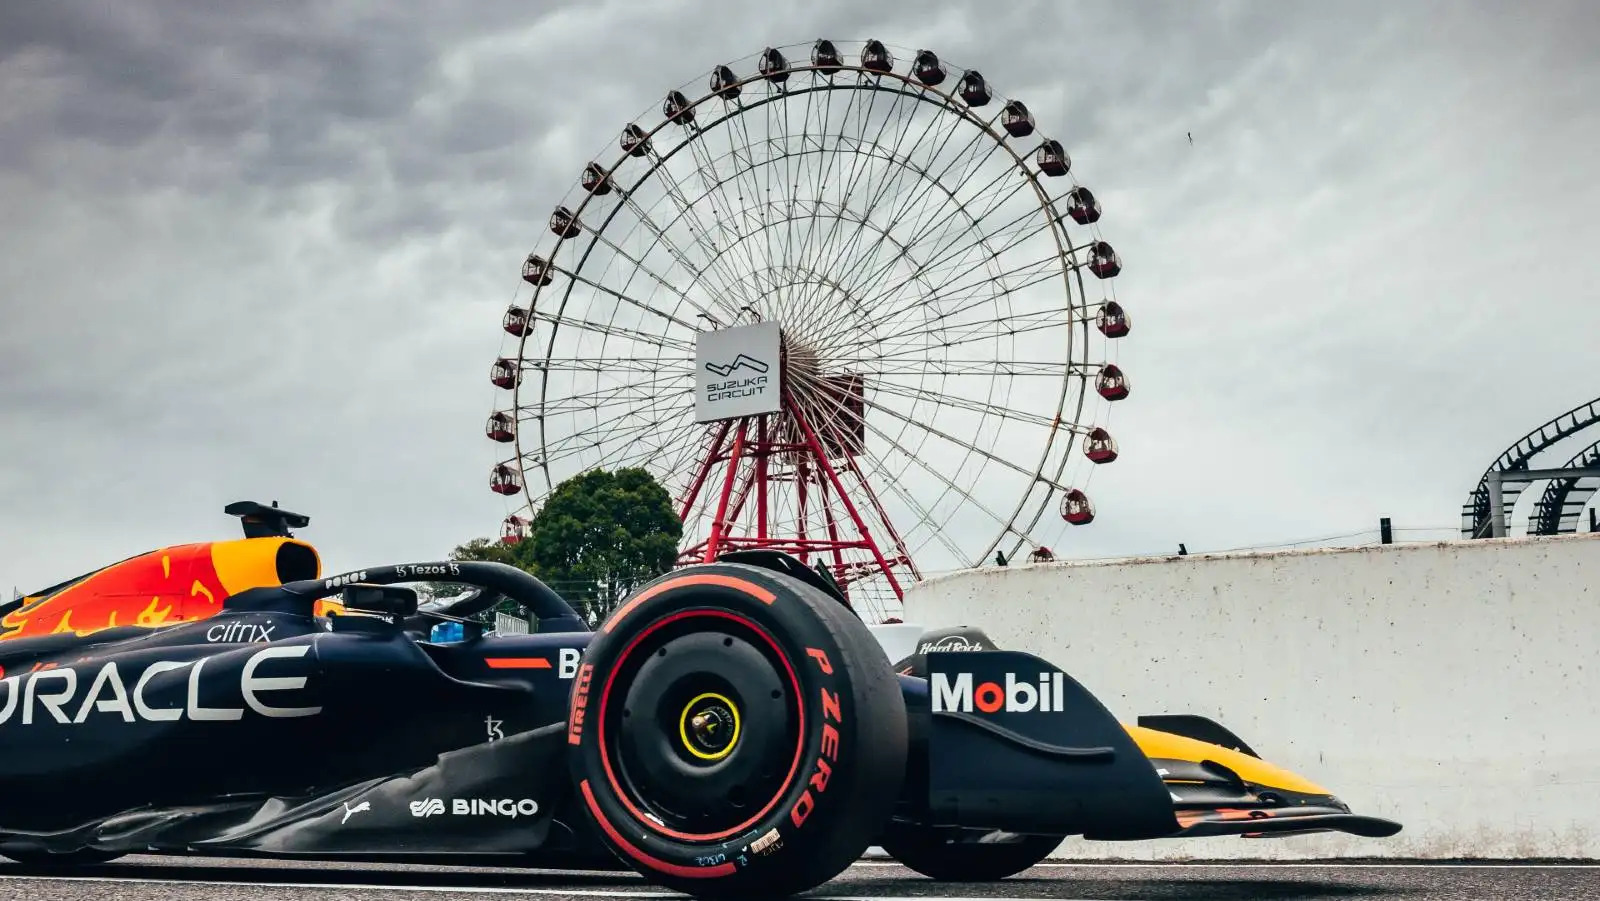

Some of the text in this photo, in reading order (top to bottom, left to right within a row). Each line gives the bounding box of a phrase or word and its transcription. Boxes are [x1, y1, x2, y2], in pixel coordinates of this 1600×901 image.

[706, 376, 768, 393] SUZUKA
[707, 386, 766, 402] CIRCUIT
[408, 564, 446, 575] Tezos
[206, 620, 276, 643] citrix
[919, 642, 953, 655] Hard
[559, 648, 587, 679] B
[931, 672, 1064, 713] Mobil
[568, 663, 594, 746] PIRELLI
[790, 647, 843, 828] P ZERO
[452, 798, 538, 819] BINGO
